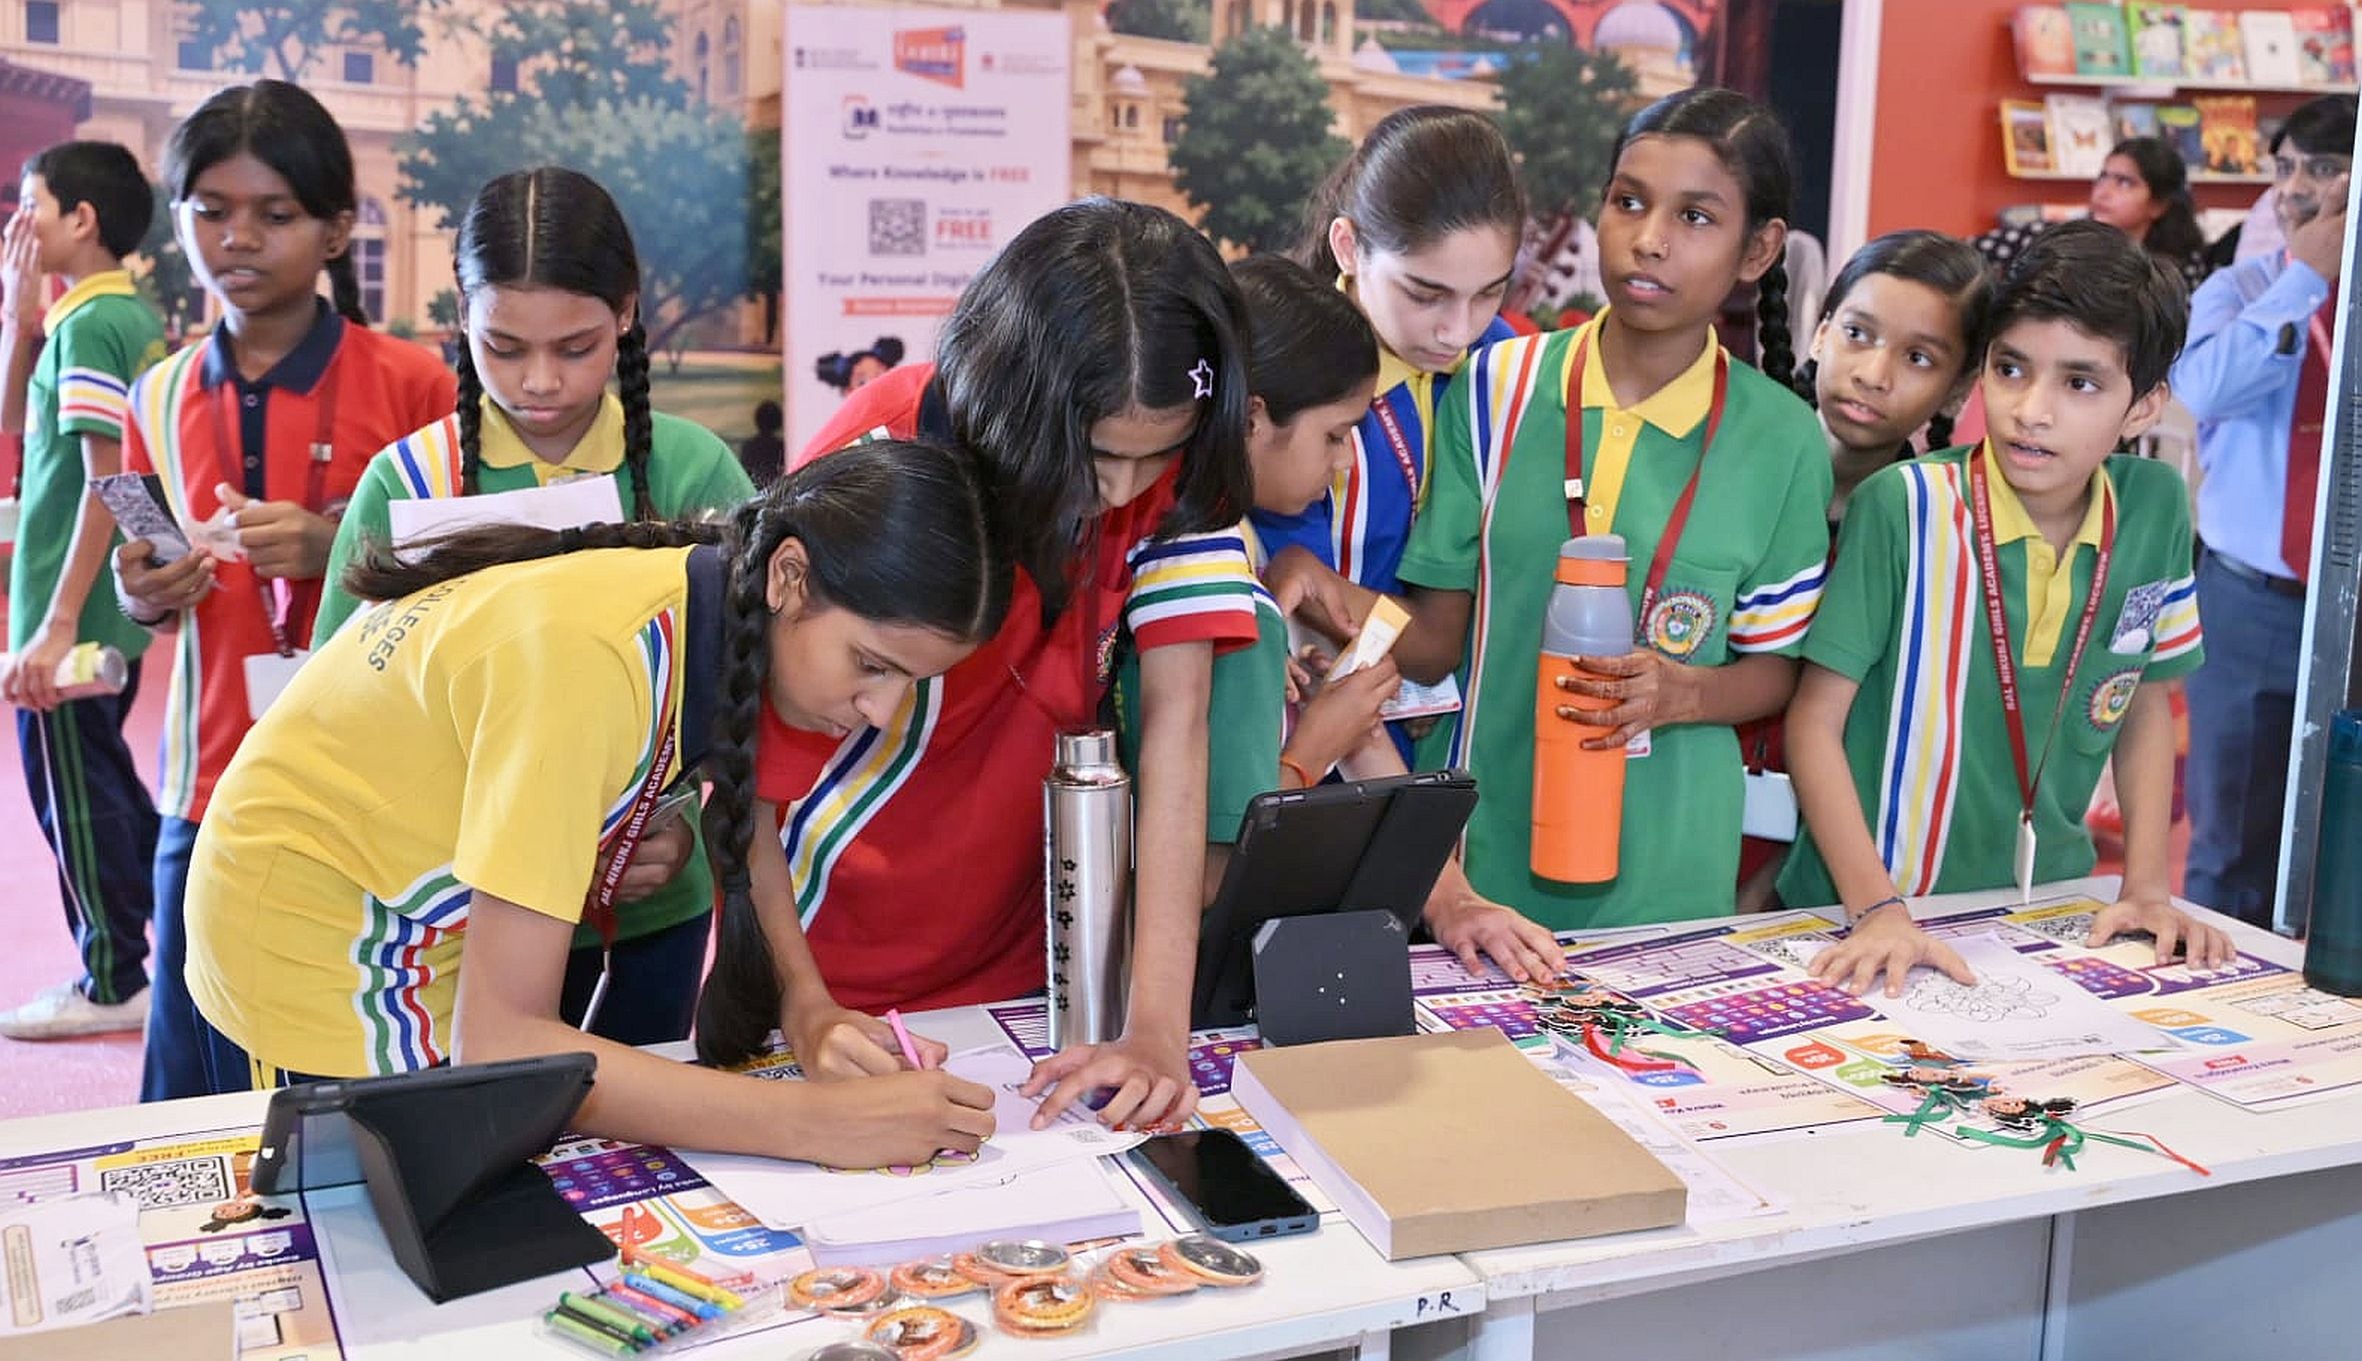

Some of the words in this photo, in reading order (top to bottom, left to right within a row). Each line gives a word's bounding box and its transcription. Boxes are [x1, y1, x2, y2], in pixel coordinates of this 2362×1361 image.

[936, 220, 993, 239] FREE
[932, 272, 971, 290] Digit
[606, 842, 632, 890] NIKUNJ
[626, 801, 651, 839] GIRLS
